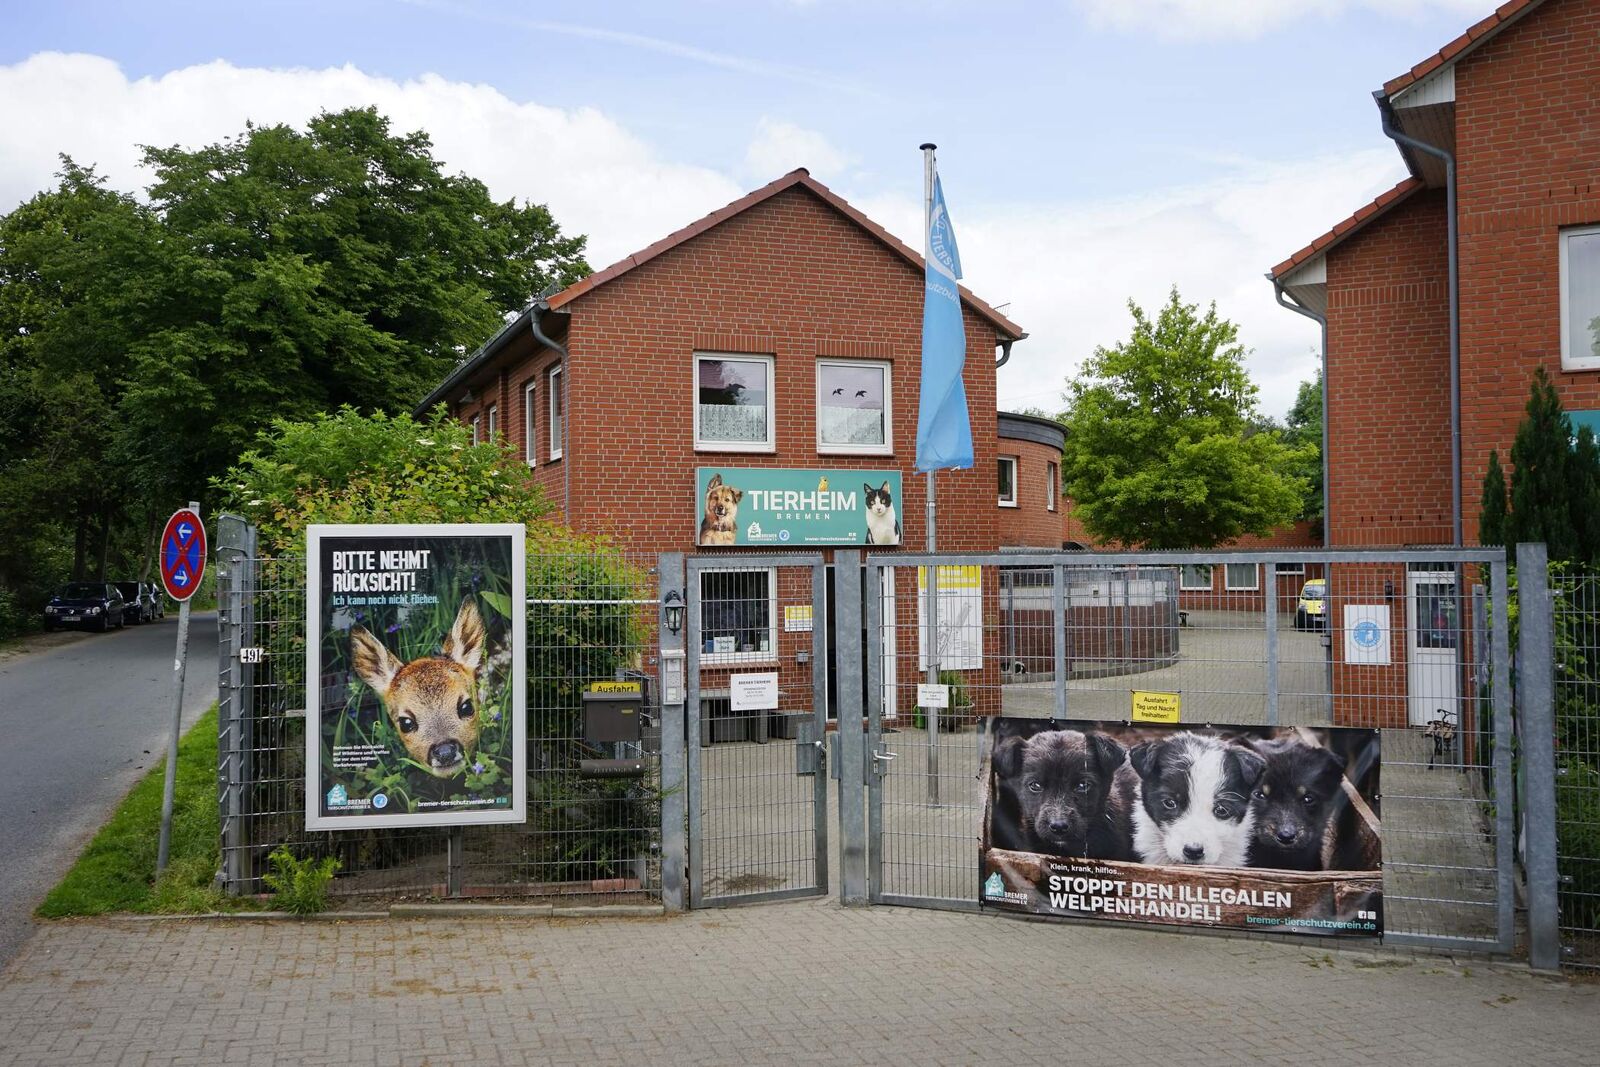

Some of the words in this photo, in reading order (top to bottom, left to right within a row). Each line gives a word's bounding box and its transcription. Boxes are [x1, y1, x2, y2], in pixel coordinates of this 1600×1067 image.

[748, 490, 857, 511] TIERHEIM
[333, 550, 376, 570] BITTE
[380, 550, 431, 570] NEHMT
[333, 570, 416, 592] RÜCKSICHT!
[333, 595, 345, 606] Ich
[347, 595, 366, 605] kann
[368, 595, 387, 605] noch
[389, 594, 408, 605] nicht
[243, 649, 260, 662] 491
[597, 685, 634, 693] Ausfahrt
[1144, 696, 1168, 704] Ausfahrt
[417, 798, 495, 807] bremer-tierschutzverein.de
[1050, 863, 1070, 872] Klein,
[1071, 865, 1094, 874] krank,
[1004, 892, 1028, 900] BREMER
[1049, 875, 1127, 896] STOPPT
[1131, 882, 1174, 900] DEN
[1178, 885, 1292, 909] ILLEGALEN
[1049, 891, 1222, 921] WELPENHANDEL!
[1246, 914, 1377, 930] bremer-tierschutzverein.de
